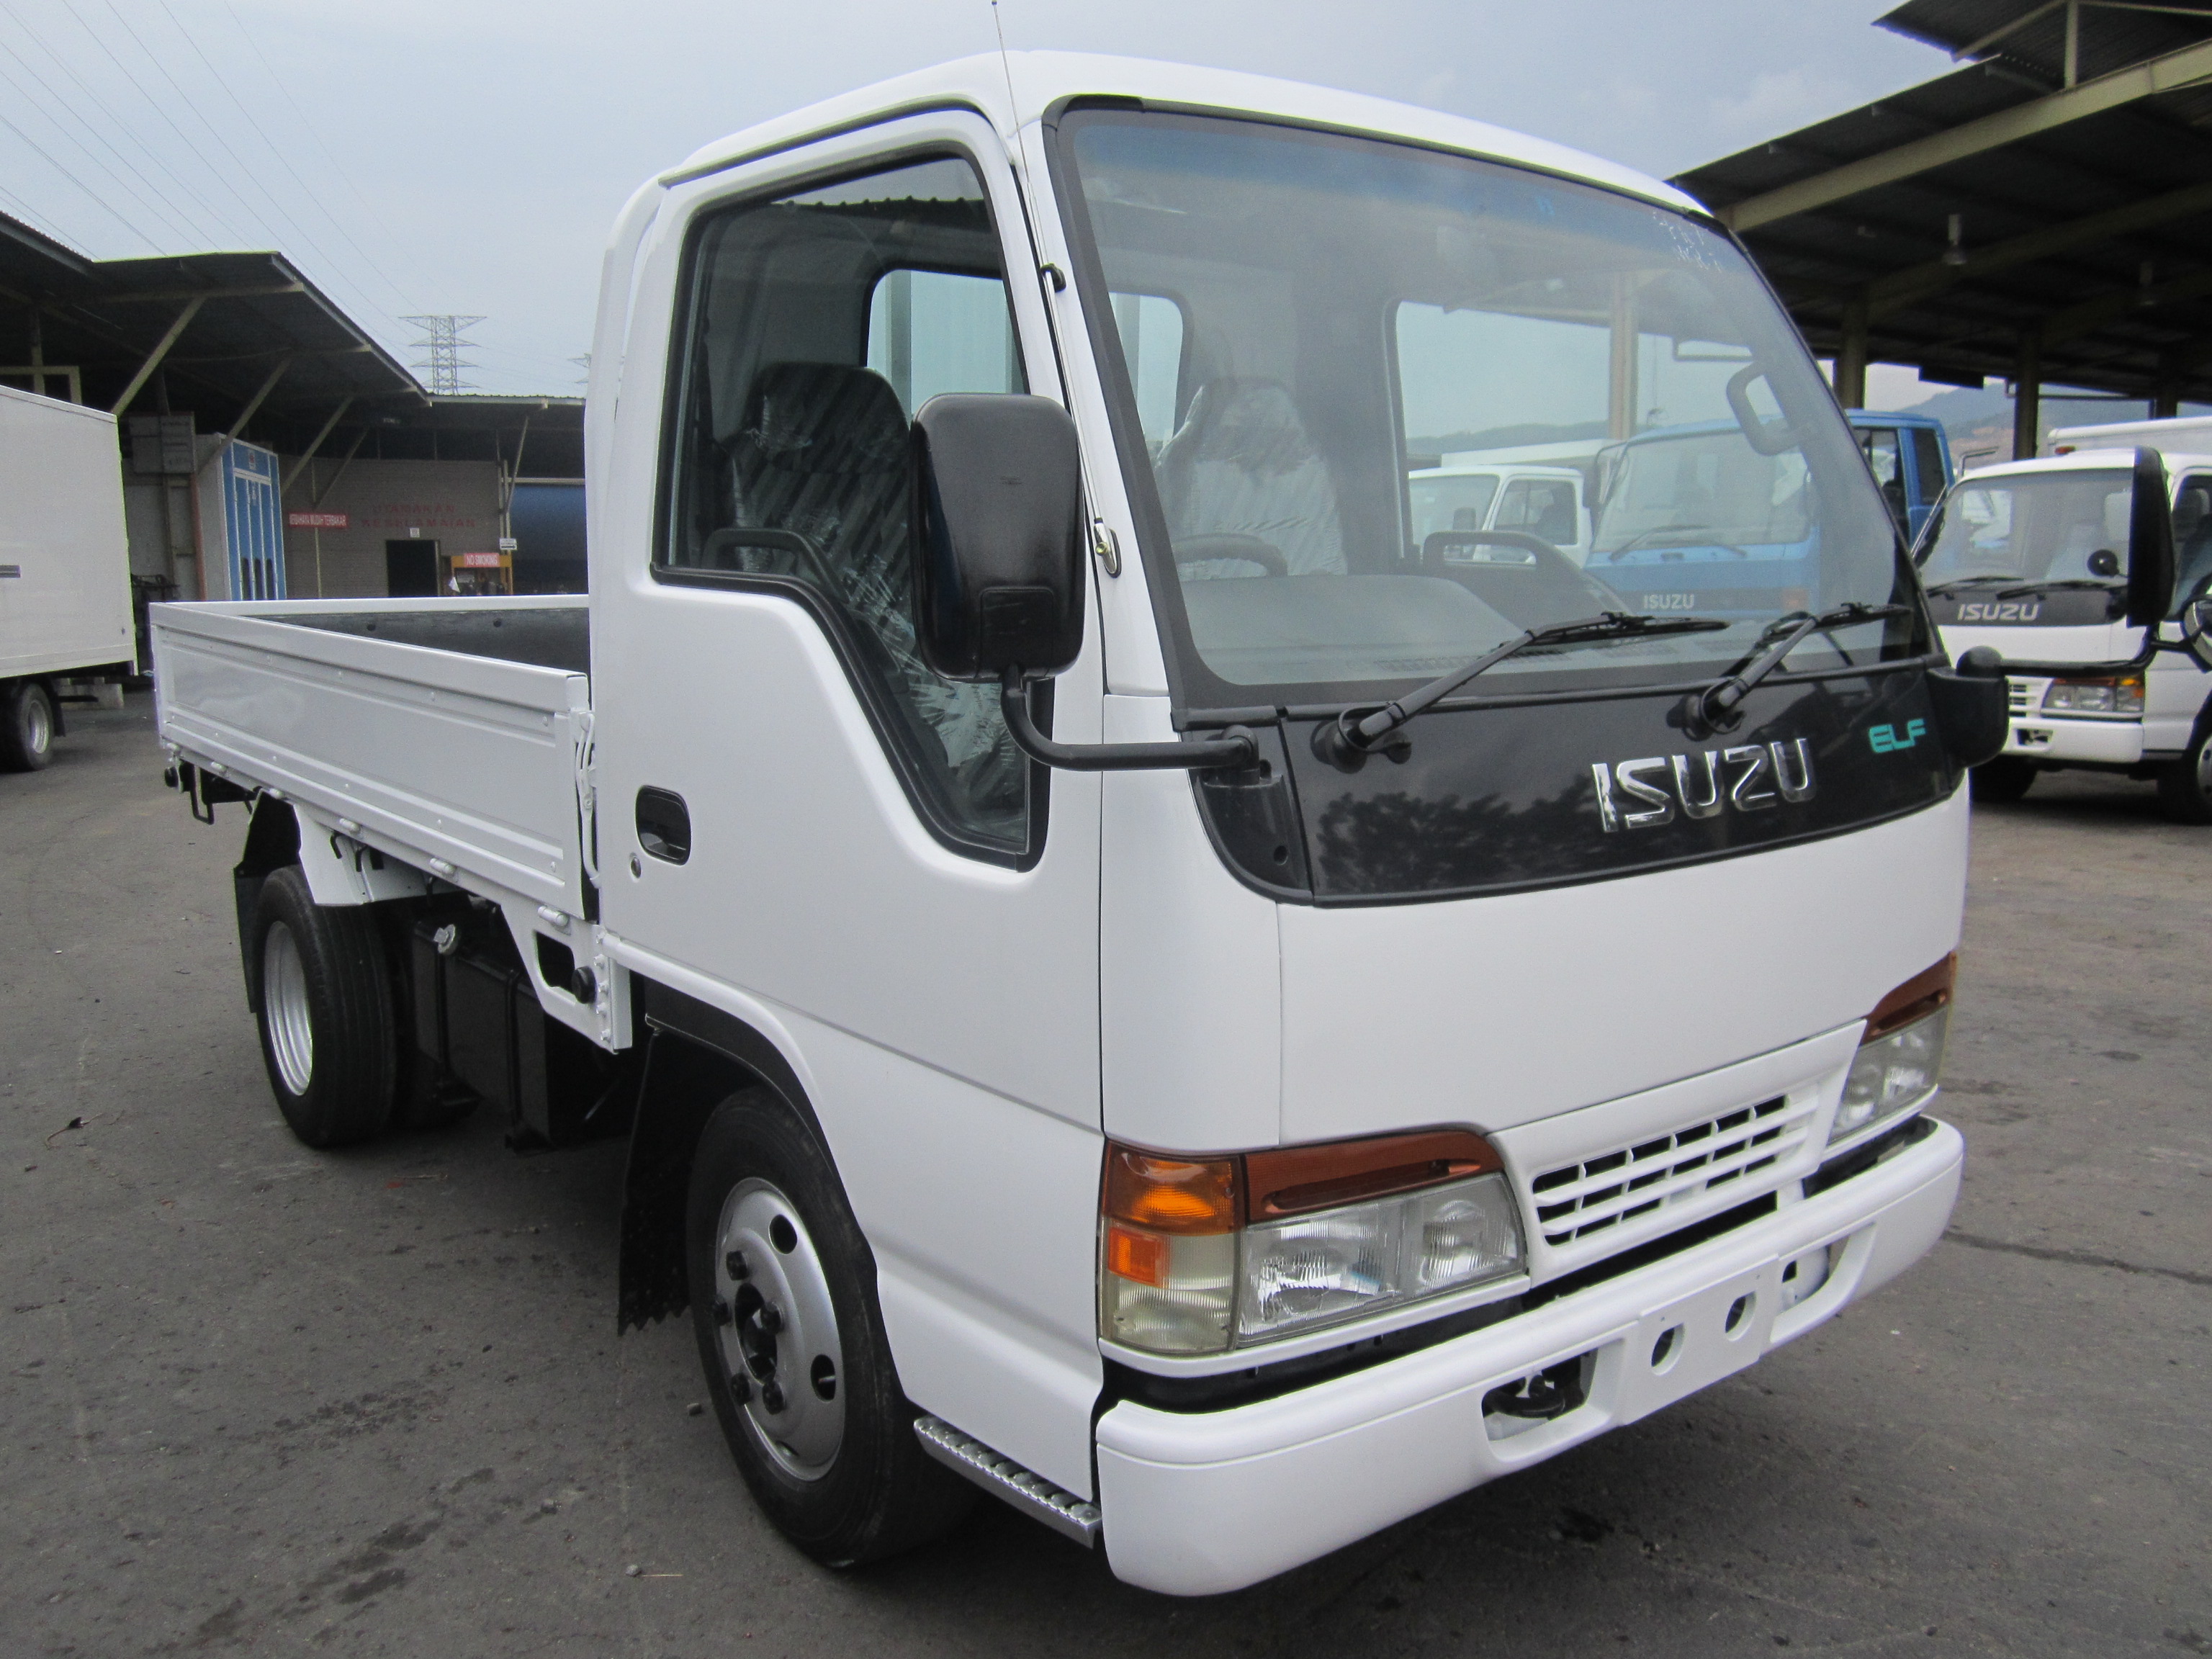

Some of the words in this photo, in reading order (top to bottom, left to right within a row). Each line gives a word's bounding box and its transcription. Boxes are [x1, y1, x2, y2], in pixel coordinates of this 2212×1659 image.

[467, 554, 475, 565] NO
[475, 554, 498, 565] SMOKING
[1644, 593, 1694, 609] ISUZU
[1957, 603, 2040, 621] ISUZU
[1869, 719, 1925, 753] ELF
[1592, 738, 1815, 833] ISUZU
